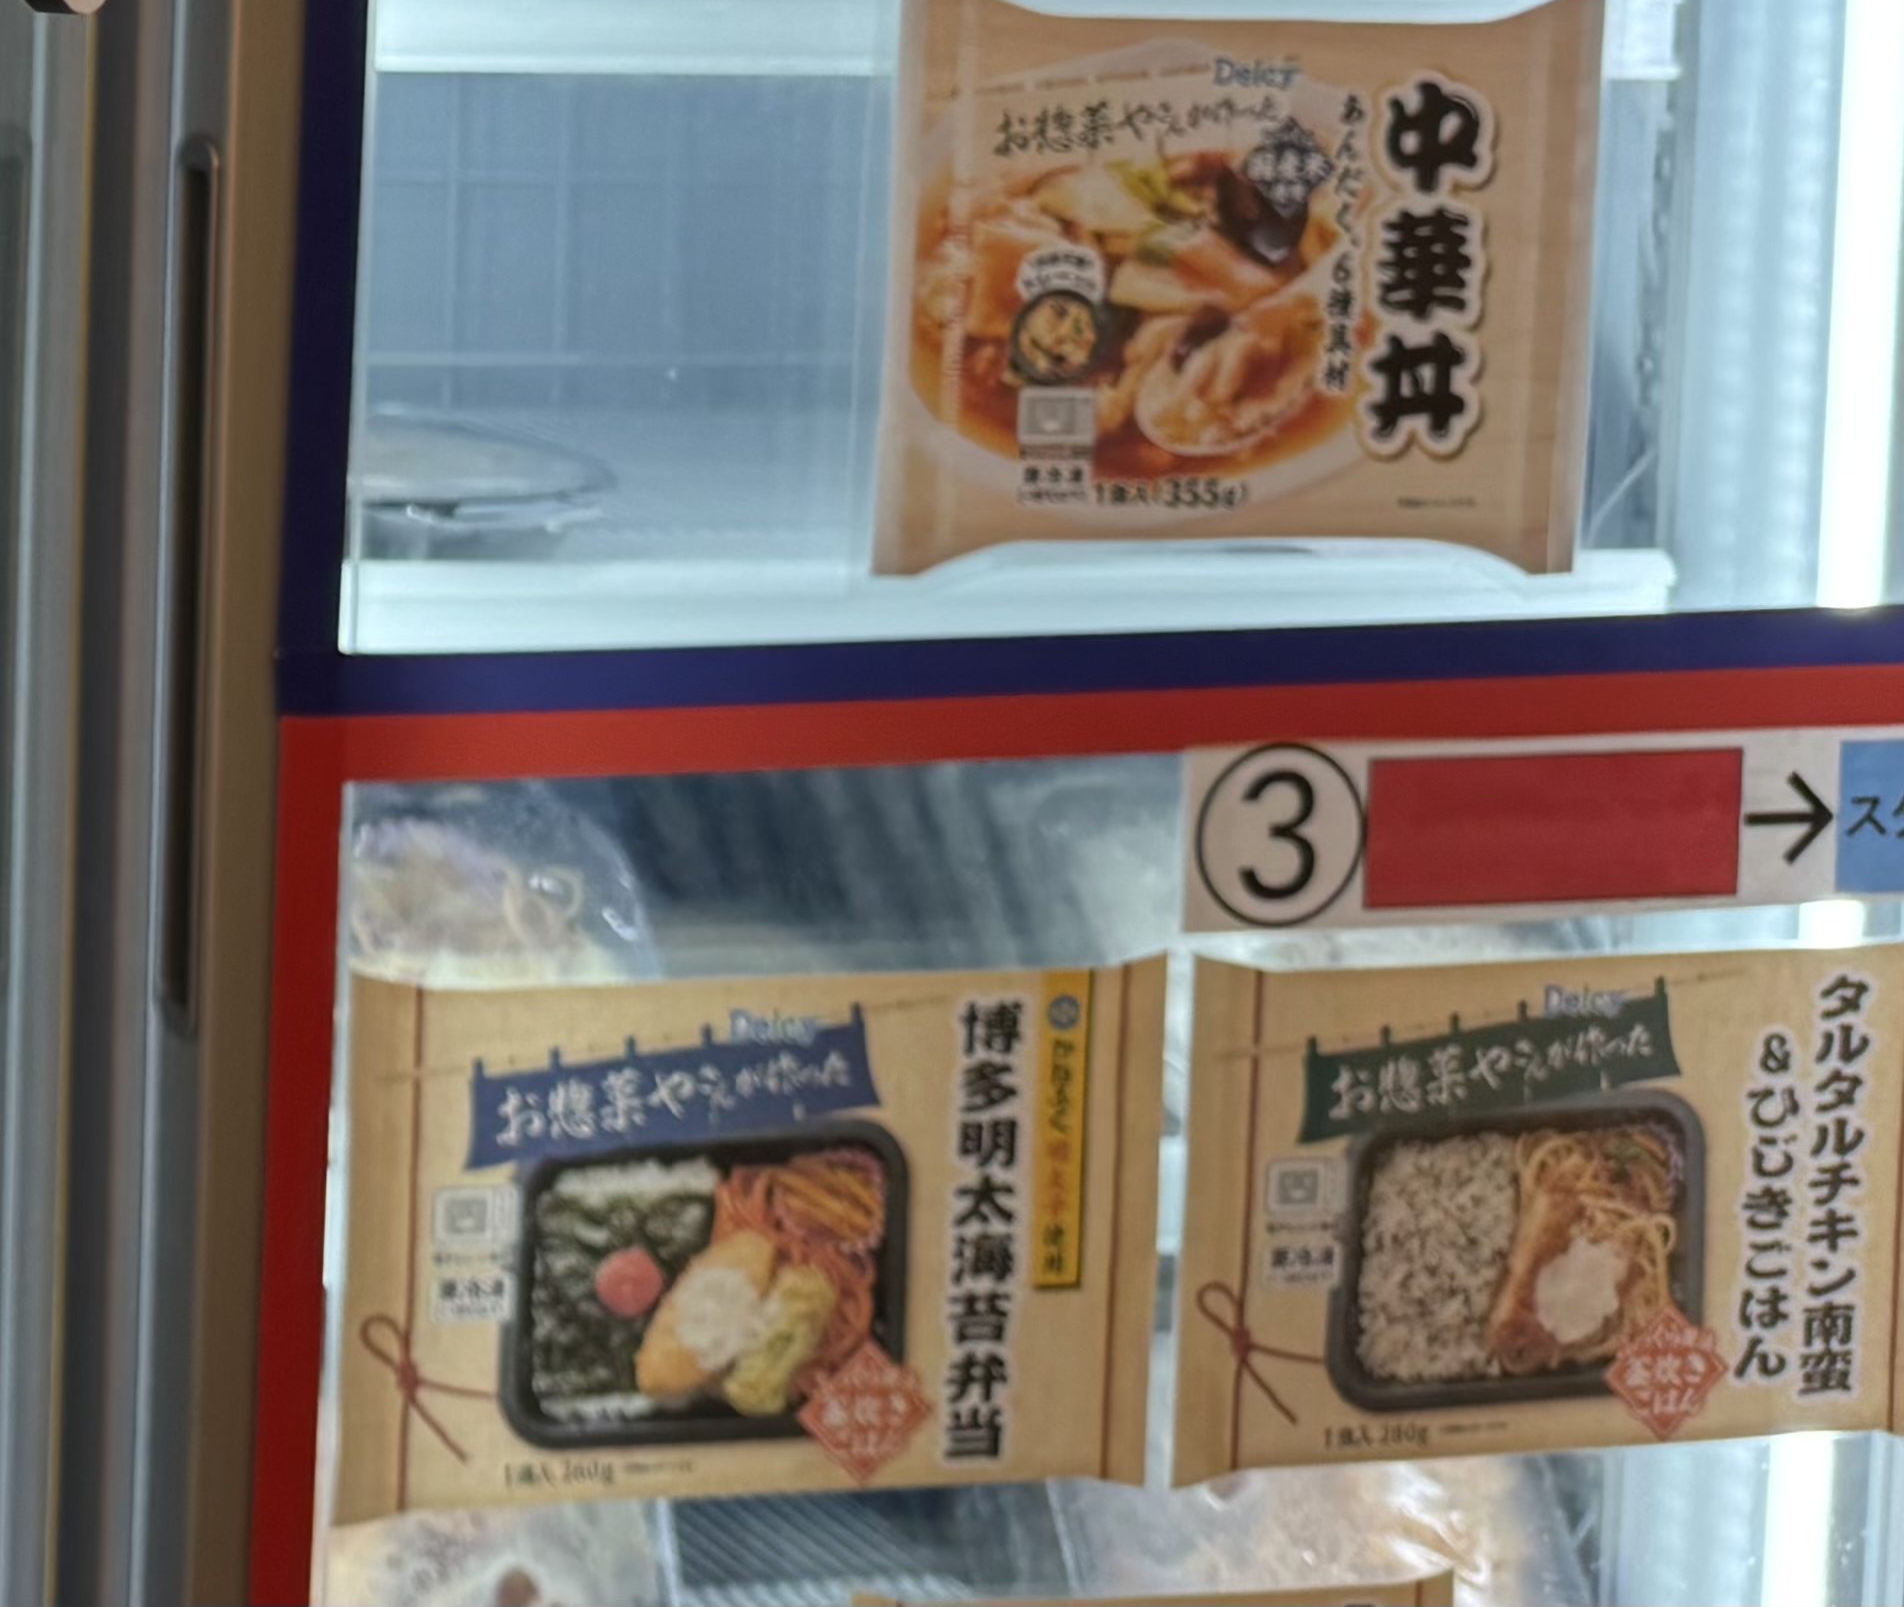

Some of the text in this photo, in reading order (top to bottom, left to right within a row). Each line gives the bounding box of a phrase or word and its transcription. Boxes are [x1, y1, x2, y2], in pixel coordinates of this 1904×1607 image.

[1213, 56, 1301, 89] Delcy
[1369, 81, 1480, 439] 中華丼
[943, 1001, 1023, 1460] 博多明太海苔弁当
[1798, 974, 1870, 1395] タルタルチキン南蛮
